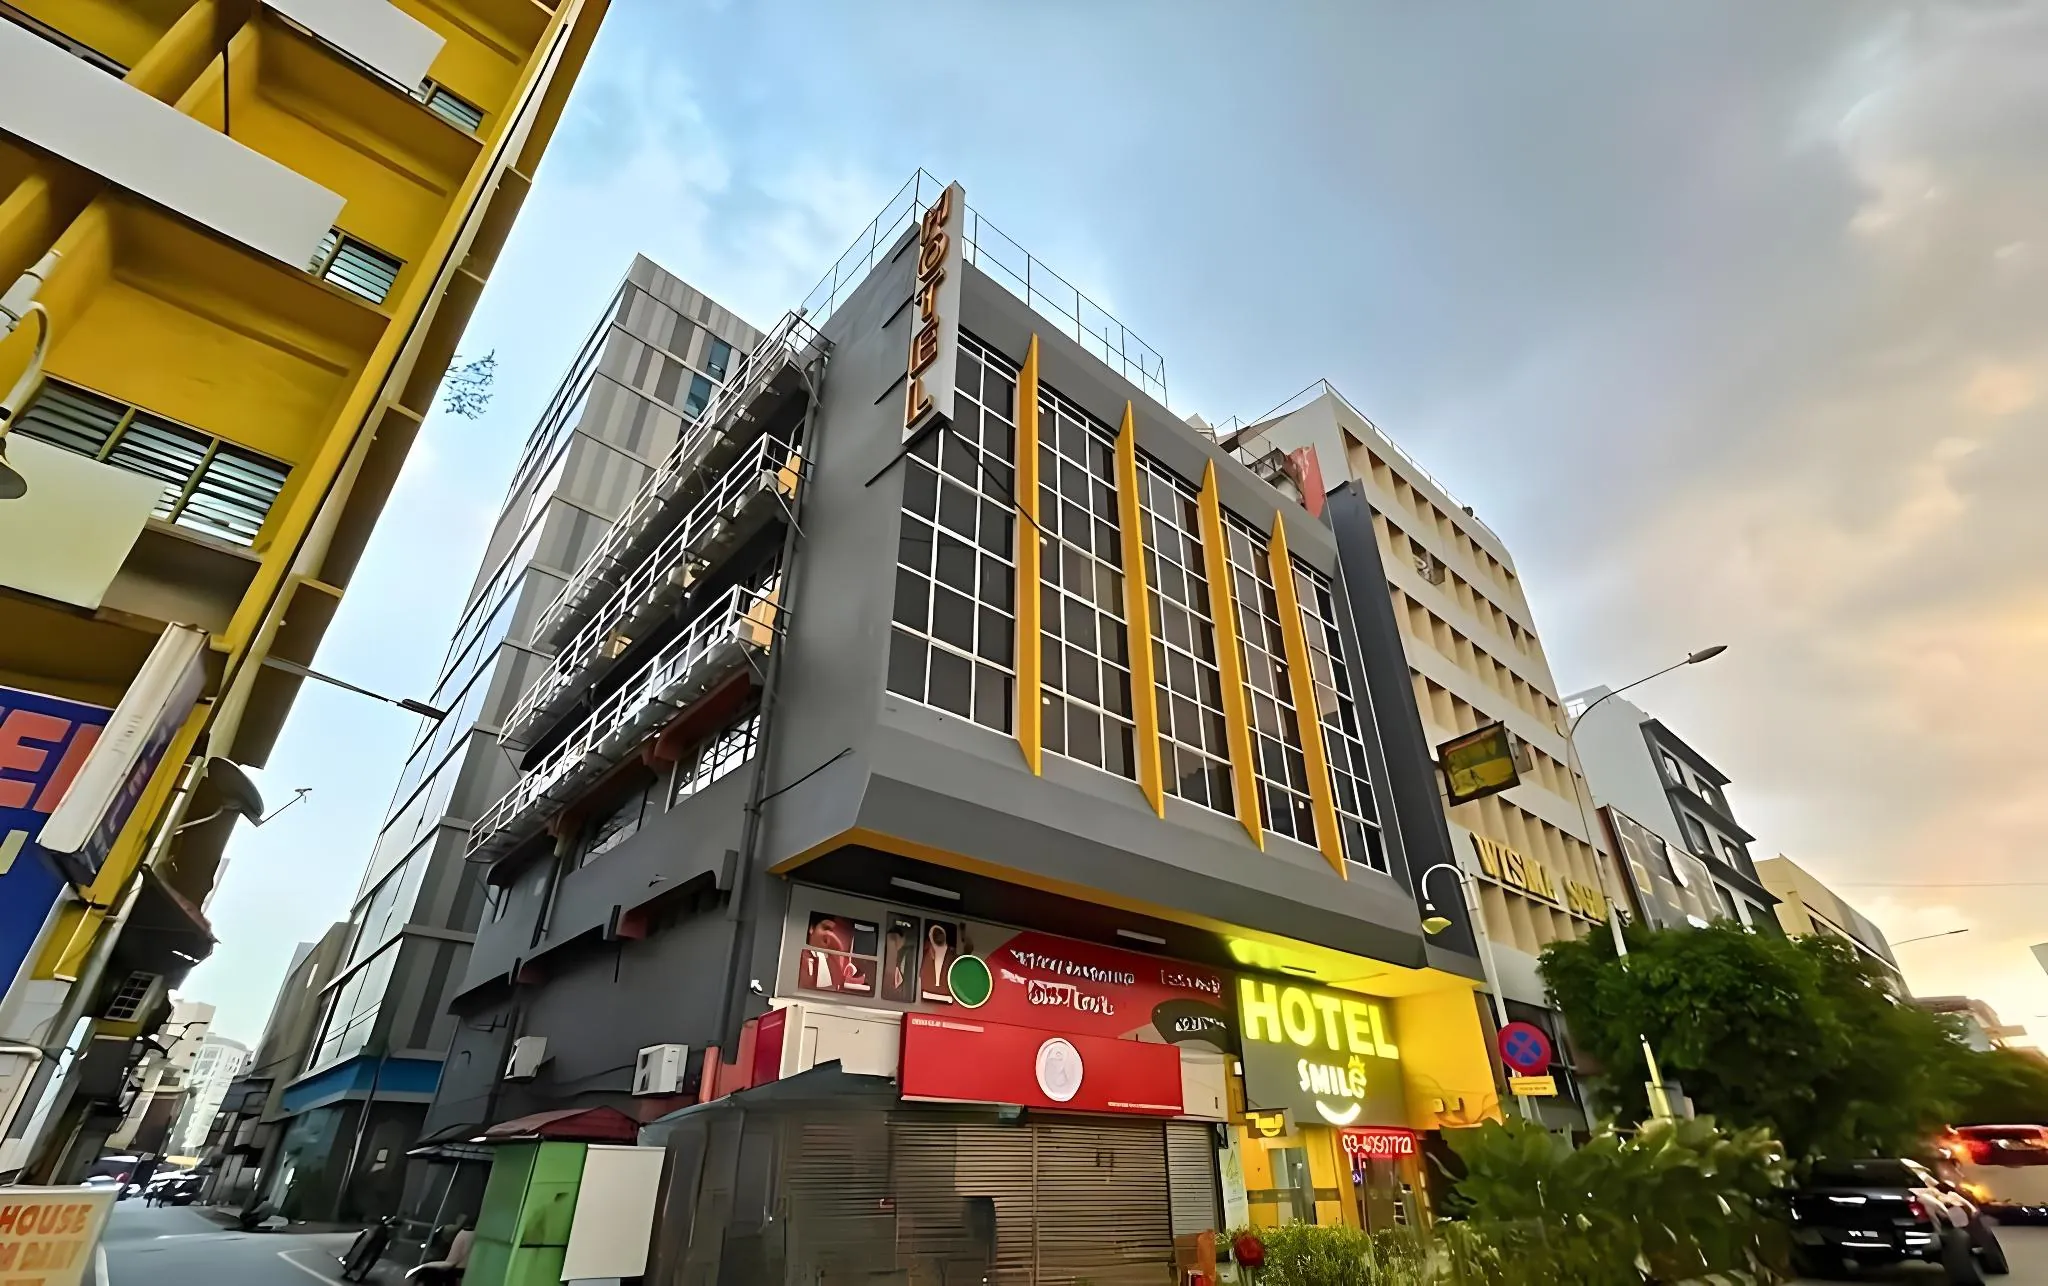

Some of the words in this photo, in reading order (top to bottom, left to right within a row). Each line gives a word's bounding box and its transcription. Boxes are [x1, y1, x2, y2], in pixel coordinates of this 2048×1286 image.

[905, 184, 954, 429] HOTEL
[1470, 832, 1560, 905] WISMA
[1240, 978, 1399, 1060] HOTEL
[0, 1204, 93, 1236] HOUSE
